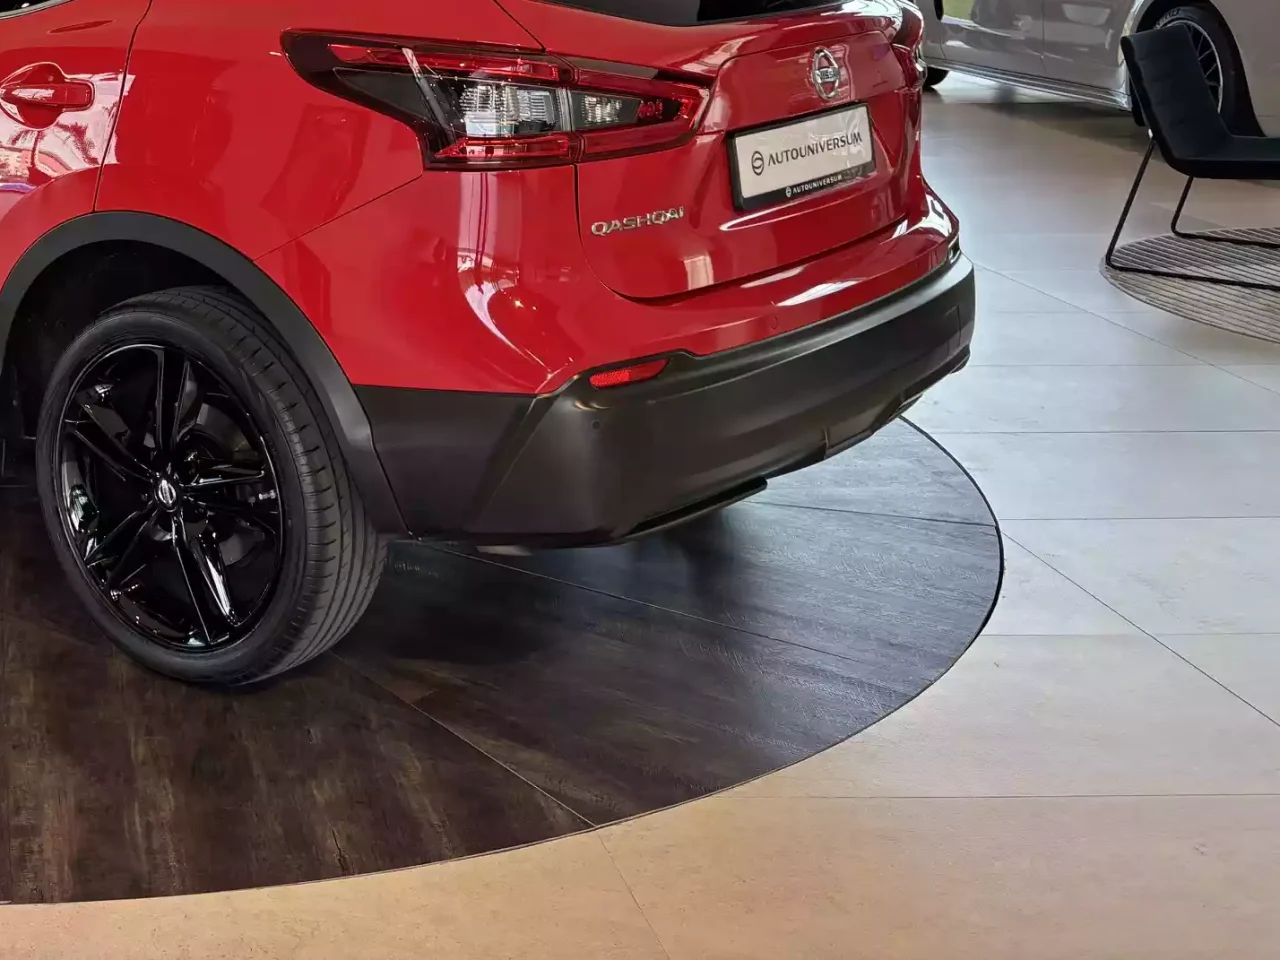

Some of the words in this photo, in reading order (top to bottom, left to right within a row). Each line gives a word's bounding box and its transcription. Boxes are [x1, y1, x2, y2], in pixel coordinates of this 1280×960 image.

[768, 131, 862, 167] AUTOUNIVERSUM
[793, 174, 842, 194] AUTOUNIVERSUM
[591, 206, 684, 236] QASHQAI
